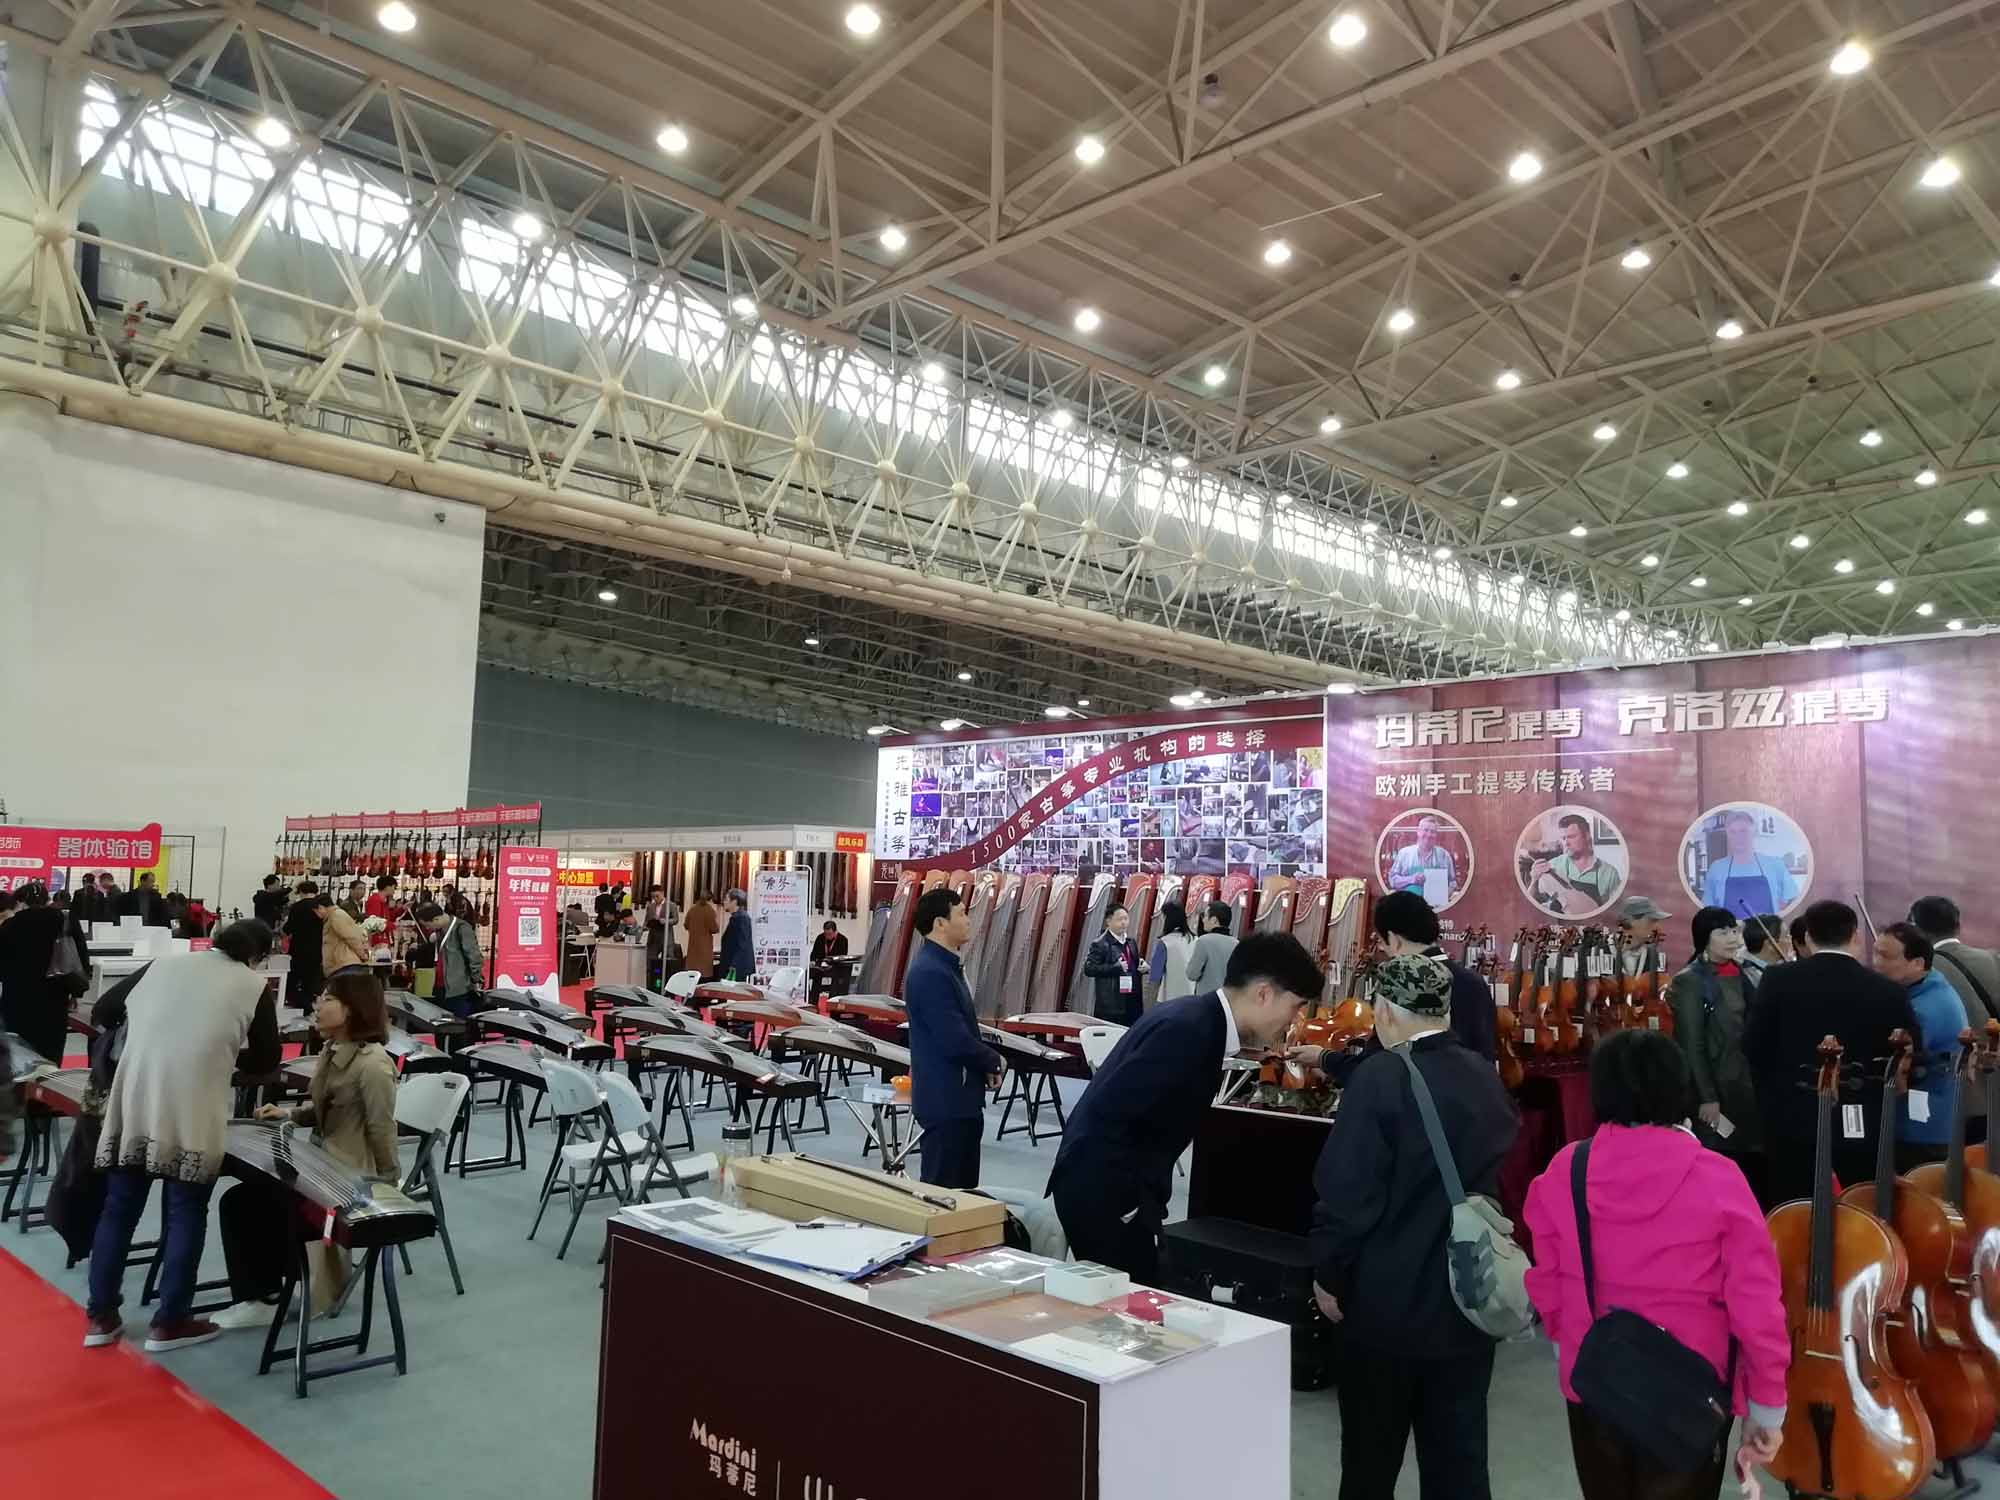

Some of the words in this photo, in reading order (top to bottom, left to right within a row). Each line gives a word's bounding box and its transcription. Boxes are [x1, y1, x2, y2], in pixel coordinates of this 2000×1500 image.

[969, 730, 1267, 866] 1500家古筝专业机构的选择
[1375, 767, 1615, 797] 欧洲手工提琴传承者
[556, 870, 594, 884] 中心加盟
[690, 1417, 757, 1472] Mardini
